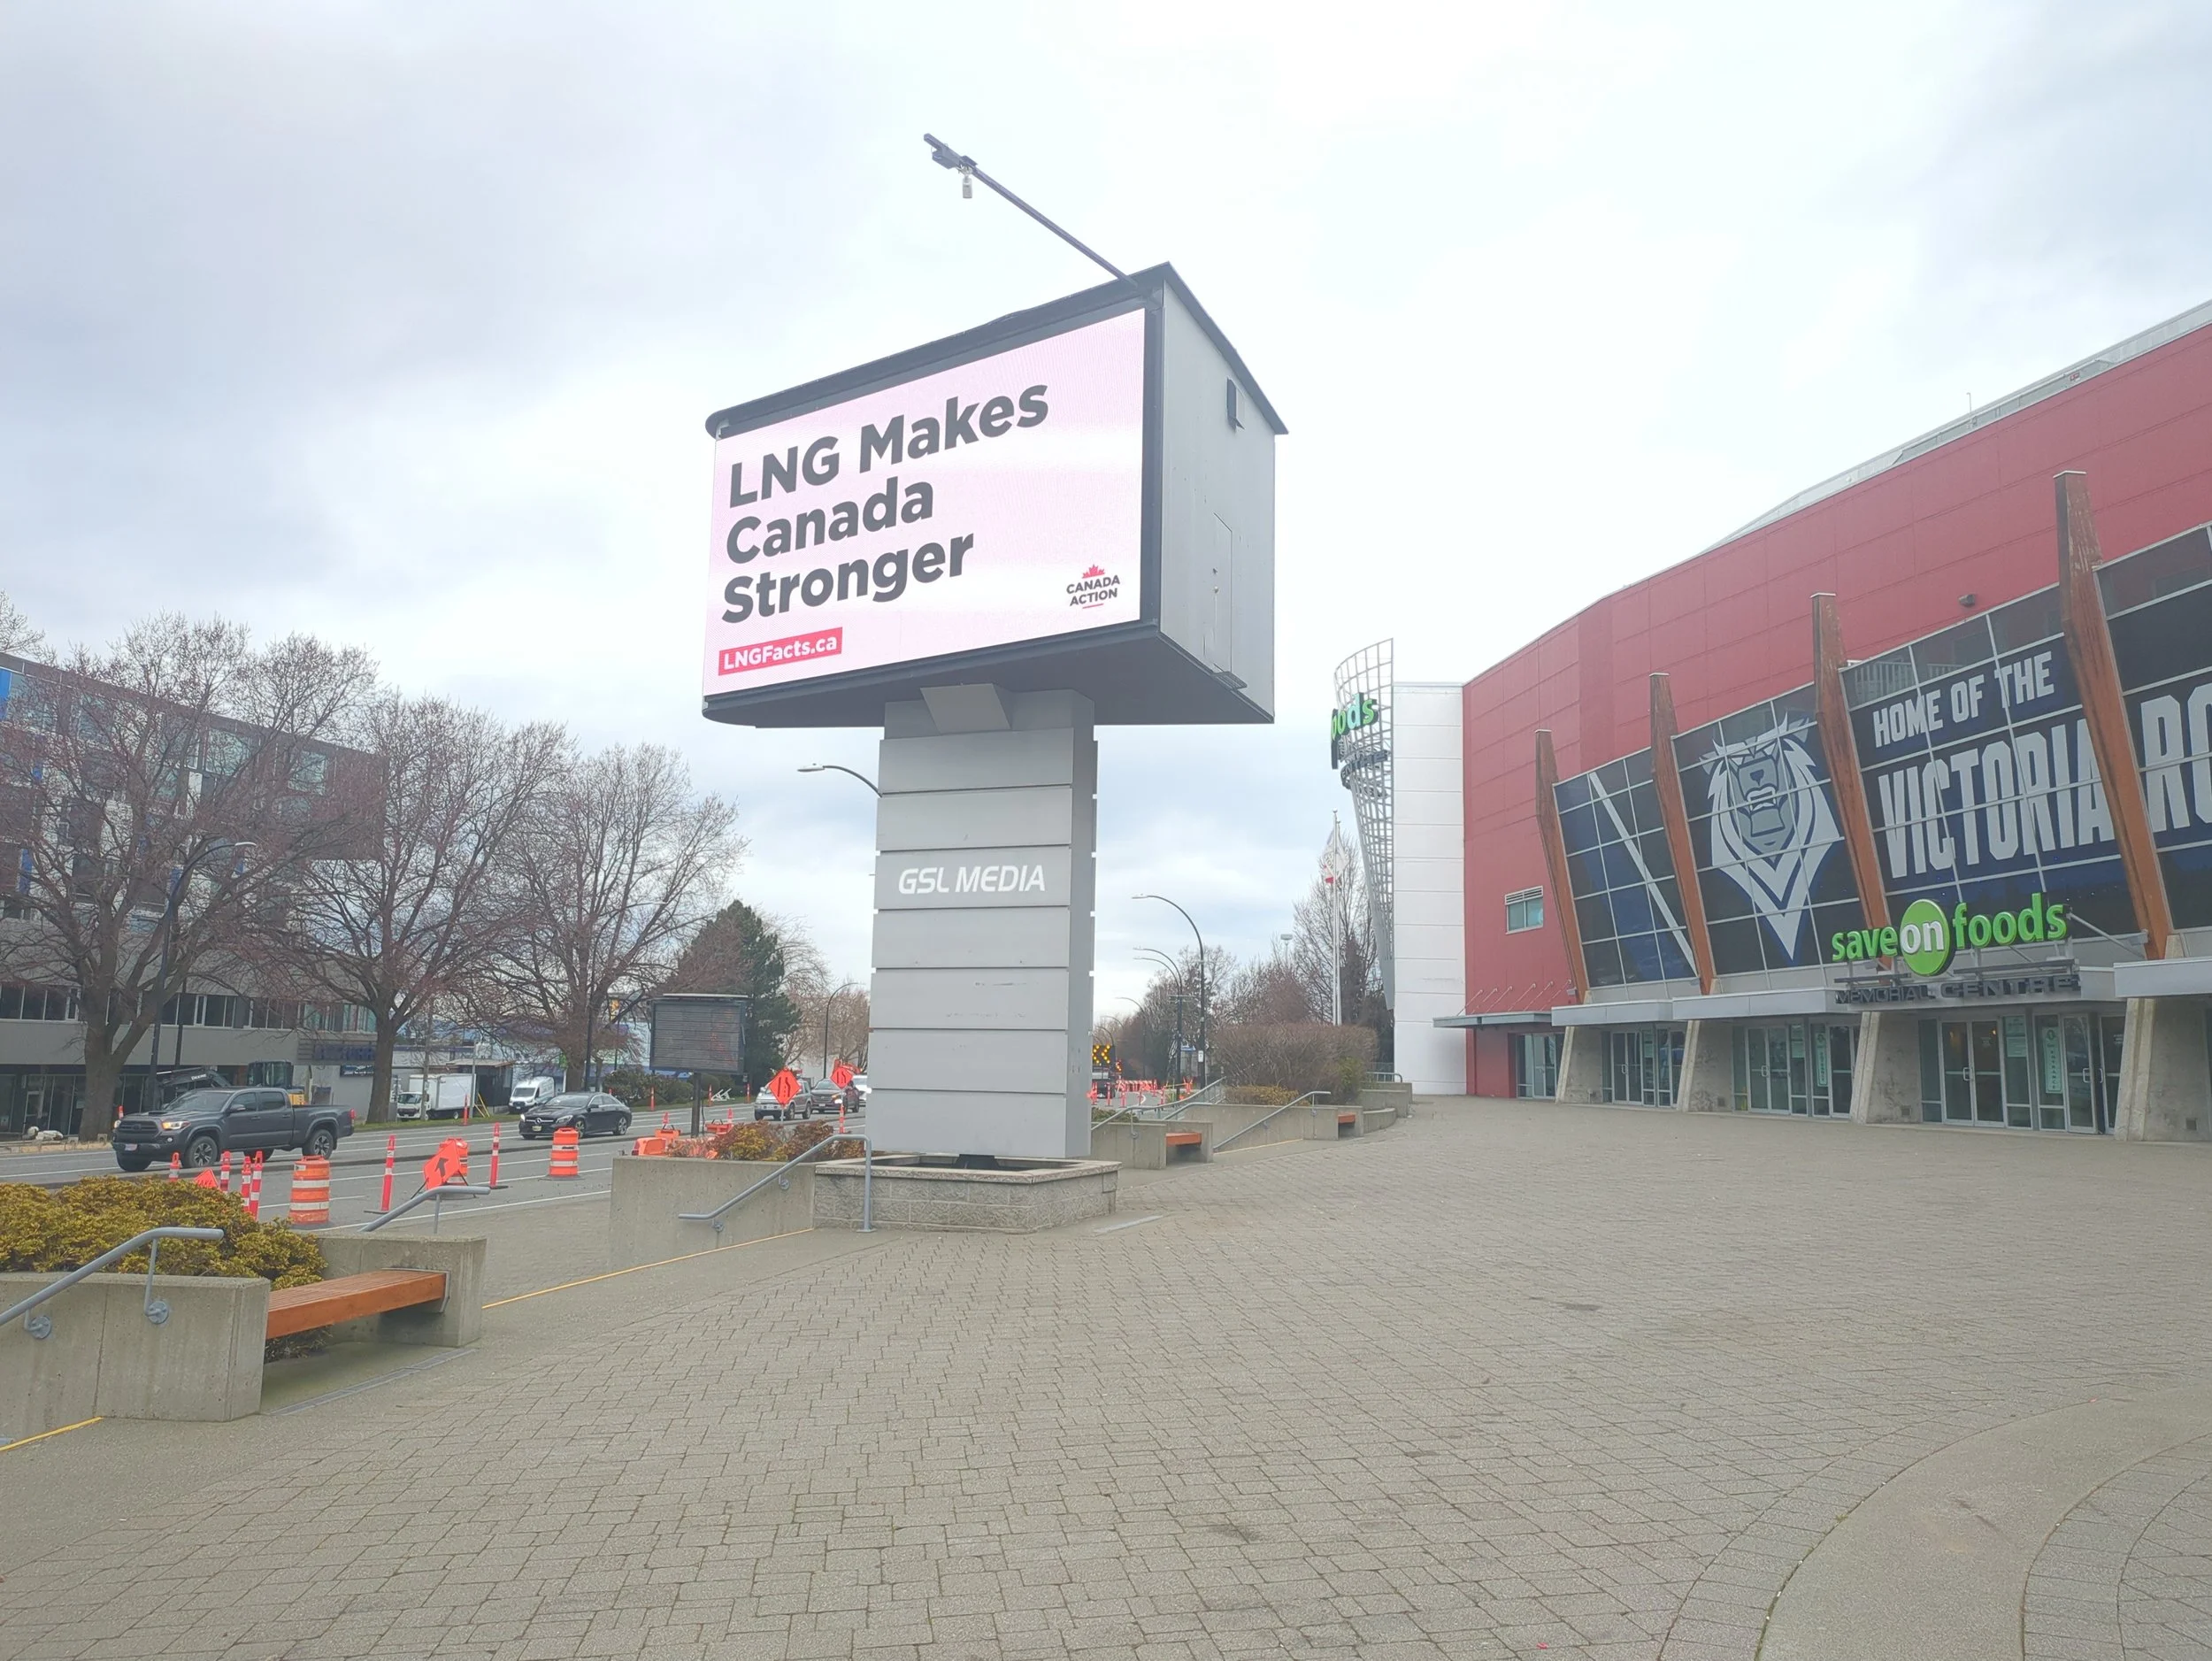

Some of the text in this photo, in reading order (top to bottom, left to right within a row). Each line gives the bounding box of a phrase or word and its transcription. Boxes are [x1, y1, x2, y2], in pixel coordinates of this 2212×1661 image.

[729, 384, 1048, 509] LNG Makes
[726, 476, 933, 565] Canada
[722, 534, 974, 623] Stronger
[1066, 574, 1120, 595] CANADA
[1069, 588, 1118, 607] ACTION
[724, 636, 838, 670] LNGFacts.ca
[1873, 650, 2055, 749] HOME OF THE
[1878, 718, 2116, 879] VICTORIA
[898, 865, 1046, 895] GSL MEDIA
[1836, 974, 2081, 1004] MEMORIAL CENTRE
